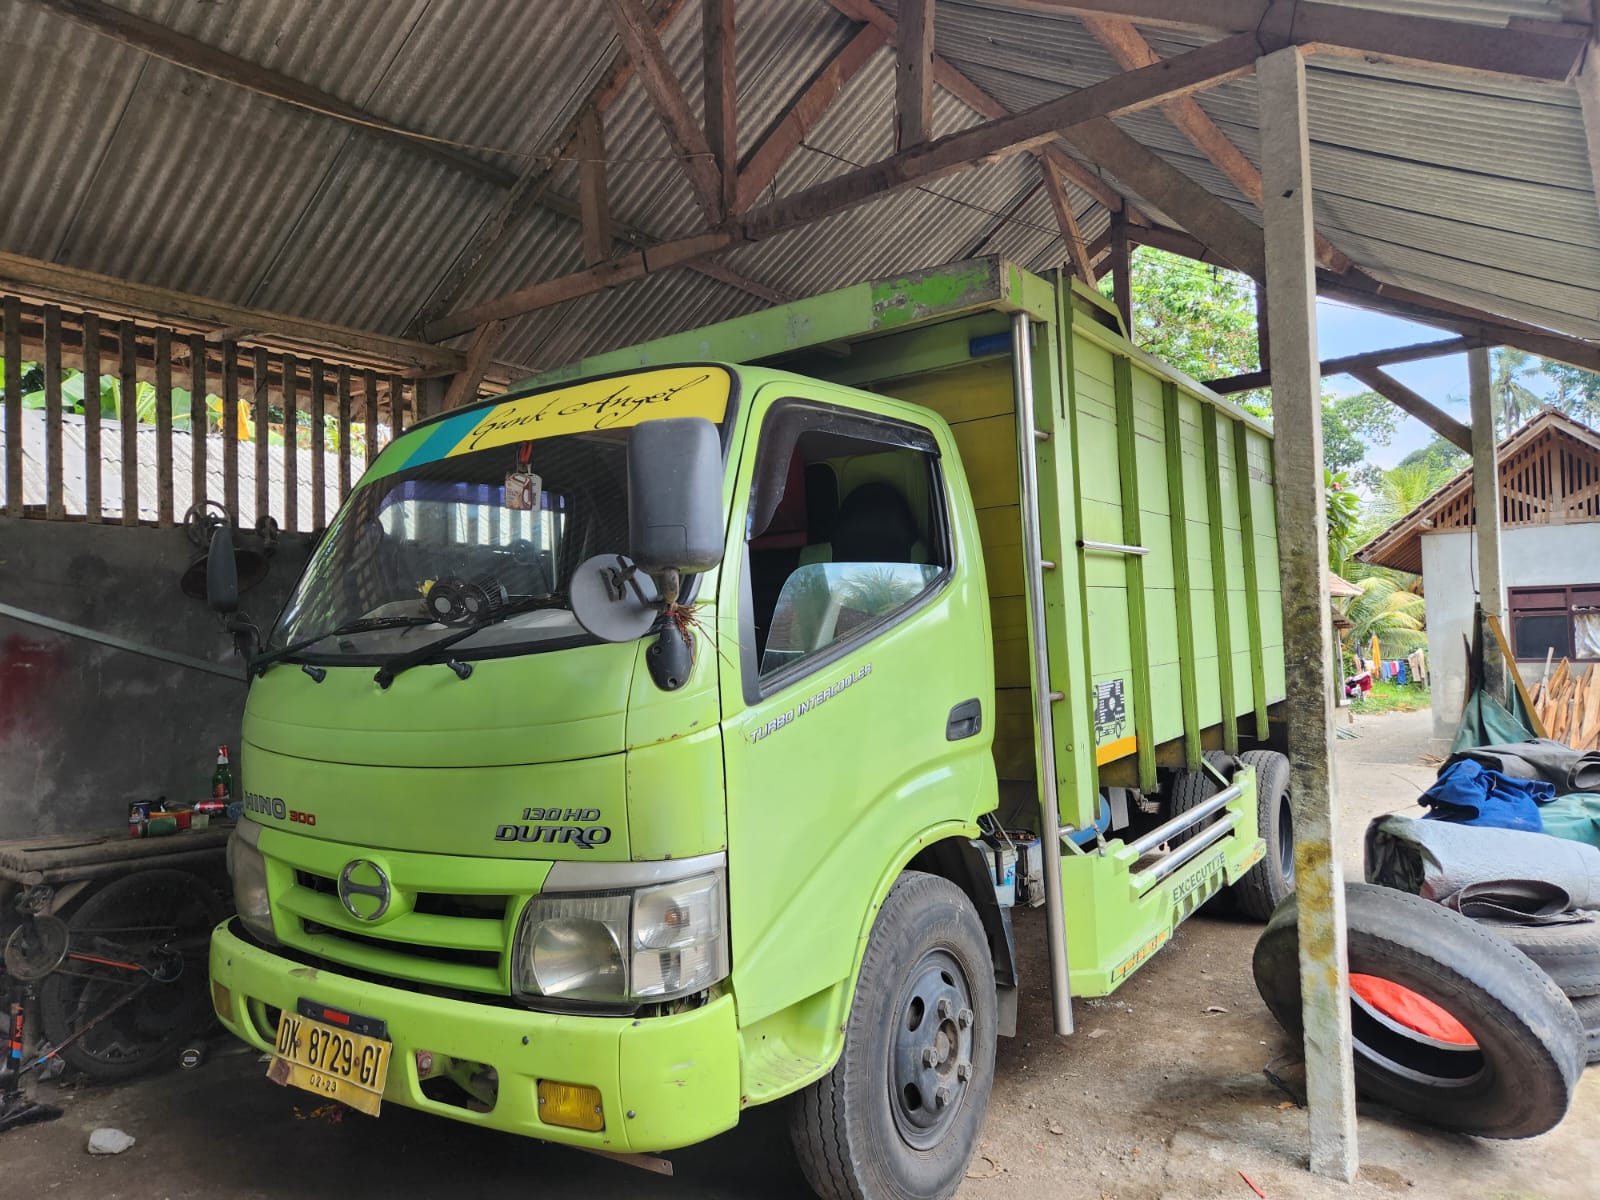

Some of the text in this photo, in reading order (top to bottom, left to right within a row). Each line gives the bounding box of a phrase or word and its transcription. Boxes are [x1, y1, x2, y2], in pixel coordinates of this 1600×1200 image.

[750, 663, 873, 744] TURBO INTERCOOLER
[244, 790, 287, 820] HINO
[289, 809, 317, 826] 300
[494, 825, 612, 849] DUTRO
[280, 1017, 302, 1058] DK
[308, 1028, 354, 1076] 8729
